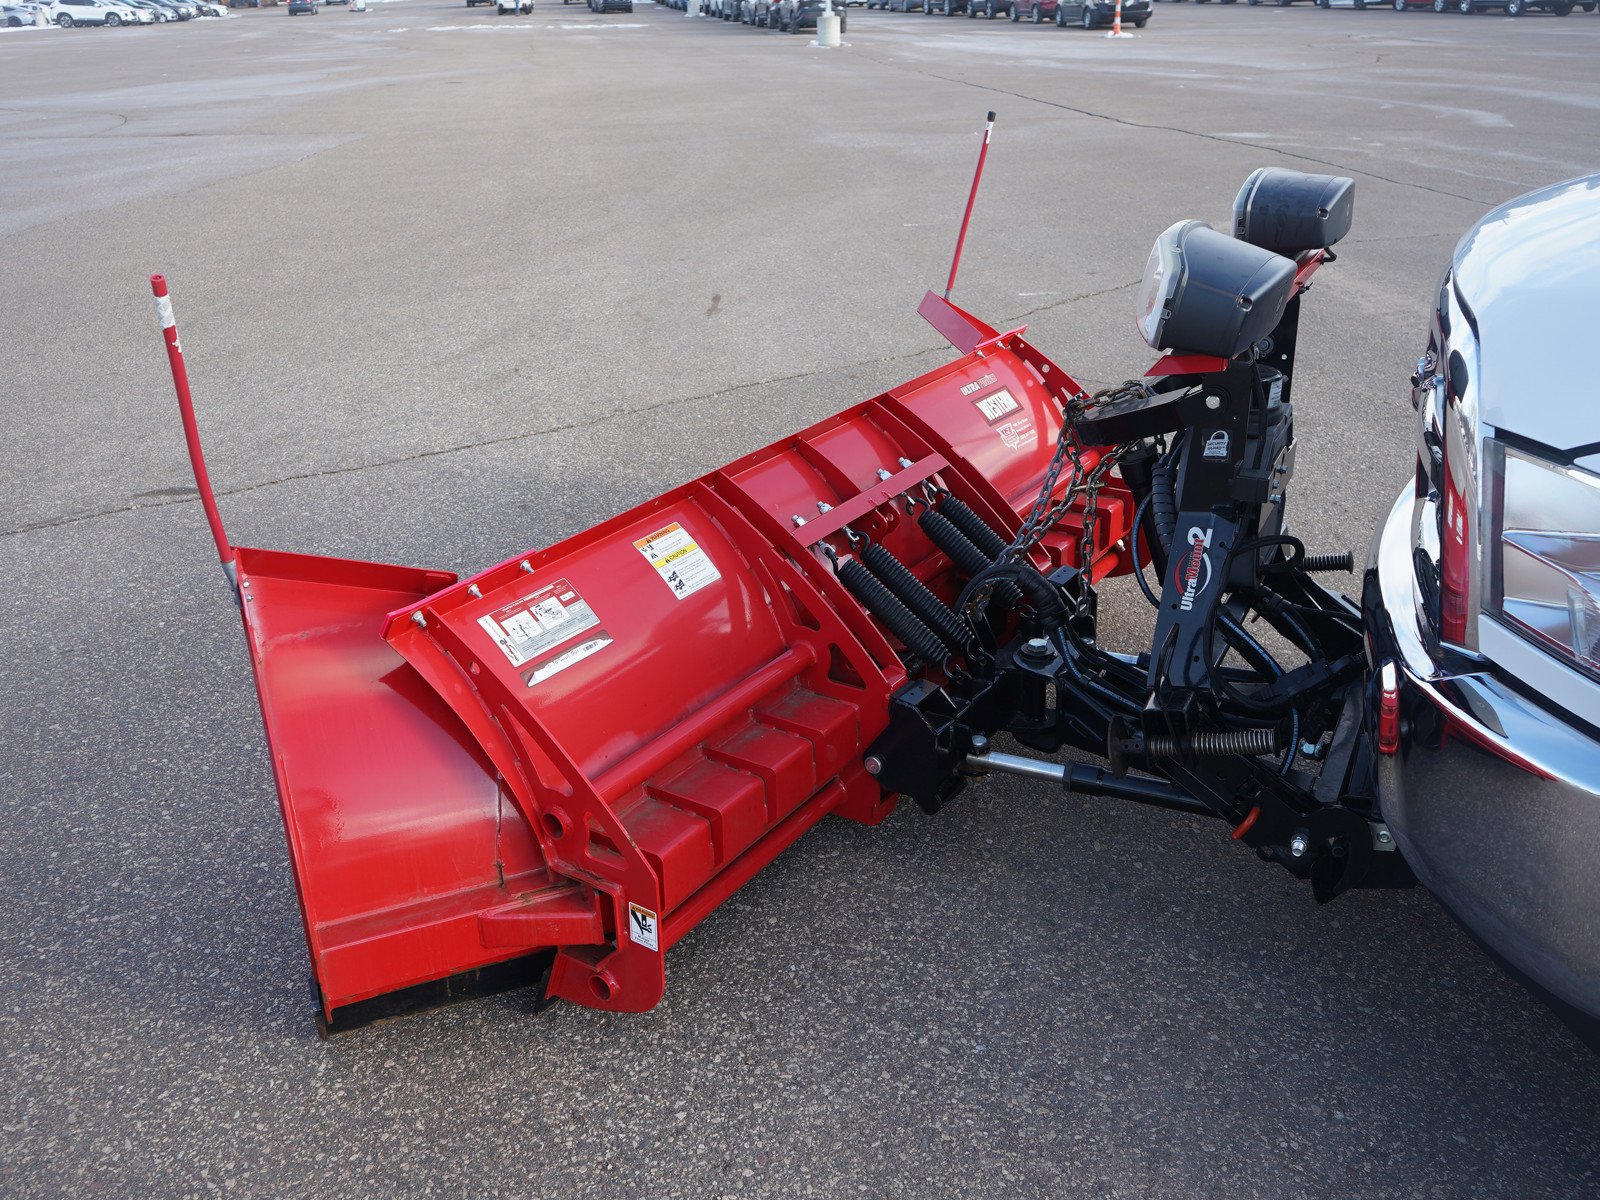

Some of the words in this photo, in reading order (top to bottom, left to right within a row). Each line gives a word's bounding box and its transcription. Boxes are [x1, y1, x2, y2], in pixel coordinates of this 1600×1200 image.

[960, 381, 981, 396] ULTRA
[651, 528, 671, 540] WARNING
[1187, 526, 1214, 549] 2
[669, 548, 688, 561] CAUTION
[1180, 538, 1205, 611] UltraMount
